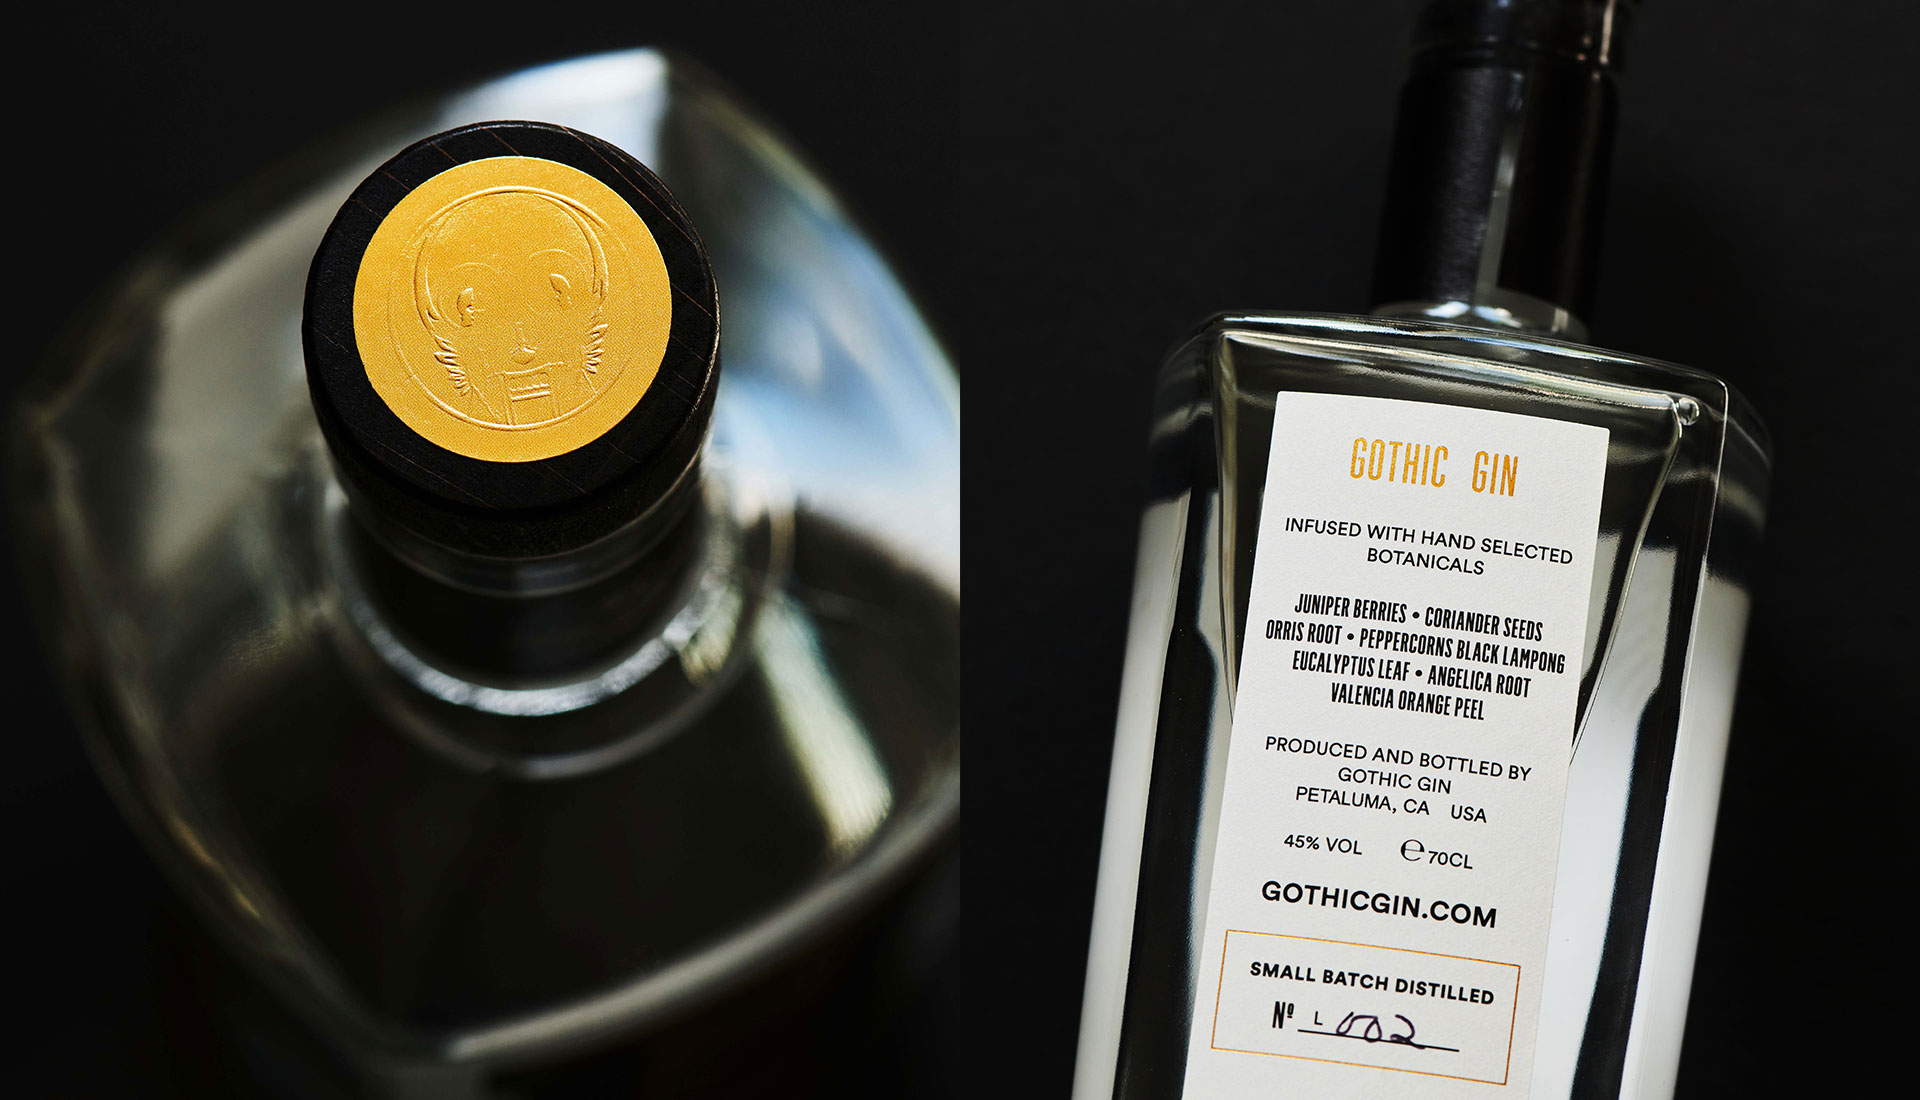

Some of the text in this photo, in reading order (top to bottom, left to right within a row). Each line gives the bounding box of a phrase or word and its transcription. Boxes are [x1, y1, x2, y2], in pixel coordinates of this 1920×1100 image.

[1350, 438, 1518, 497] GOTHIC GIN
[1286, 518, 1572, 564] INFUSED WITH HAND SELECTED
[1368, 548, 1484, 575] BOTANICALS
[1295, 594, 1543, 642] JUNIPER BERRIES CORIANDER SEEDS
[1266, 620, 1565, 674] ORRIS ROOT PEPPERCORNS BLACK LAMPONG
[1293, 650, 1531, 697] EUCALYPTUS LEAF ANGELICA ROOT
[1332, 683, 1484, 720] VALENCIA ORANGE PEEL
[1266, 736, 1531, 781] PRODUCED AND BOTTLED BY
[1338, 767, 1451, 794] GOTHIC GIN
[1296, 786, 1486, 823] PETALUMA, CA USA
[1284, 835, 1319, 850] 45%
[1326, 837, 1362, 855] VOL
[1262, 881, 1496, 928] GOTHICGIN.COM
[1250, 962, 1494, 1005] SMALL BATCH DISTILLED
